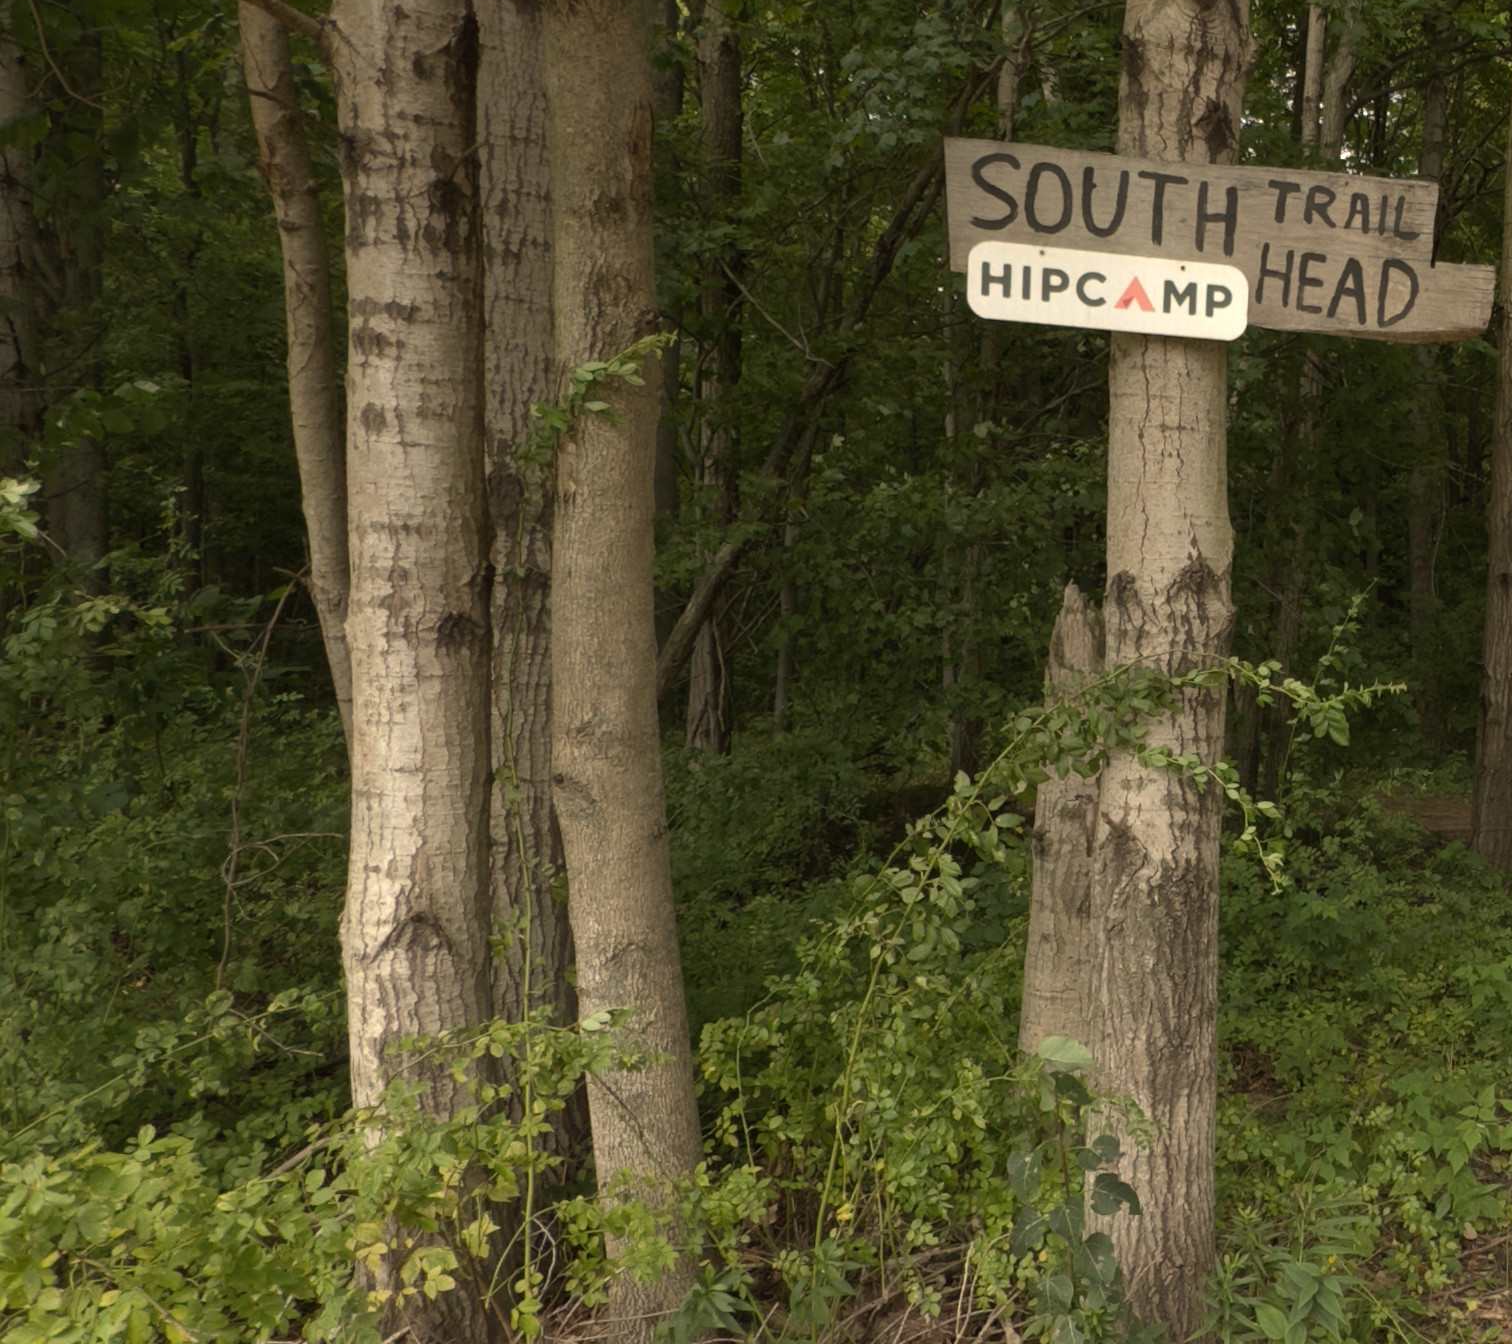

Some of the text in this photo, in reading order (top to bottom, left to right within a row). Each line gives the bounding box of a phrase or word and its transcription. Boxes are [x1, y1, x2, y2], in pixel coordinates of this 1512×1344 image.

[970, 152, 1420, 256] SOUTH TRAIL
[981, 261, 1233, 318] HIPCAMP
[1255, 242, 1420, 328] HEAD
